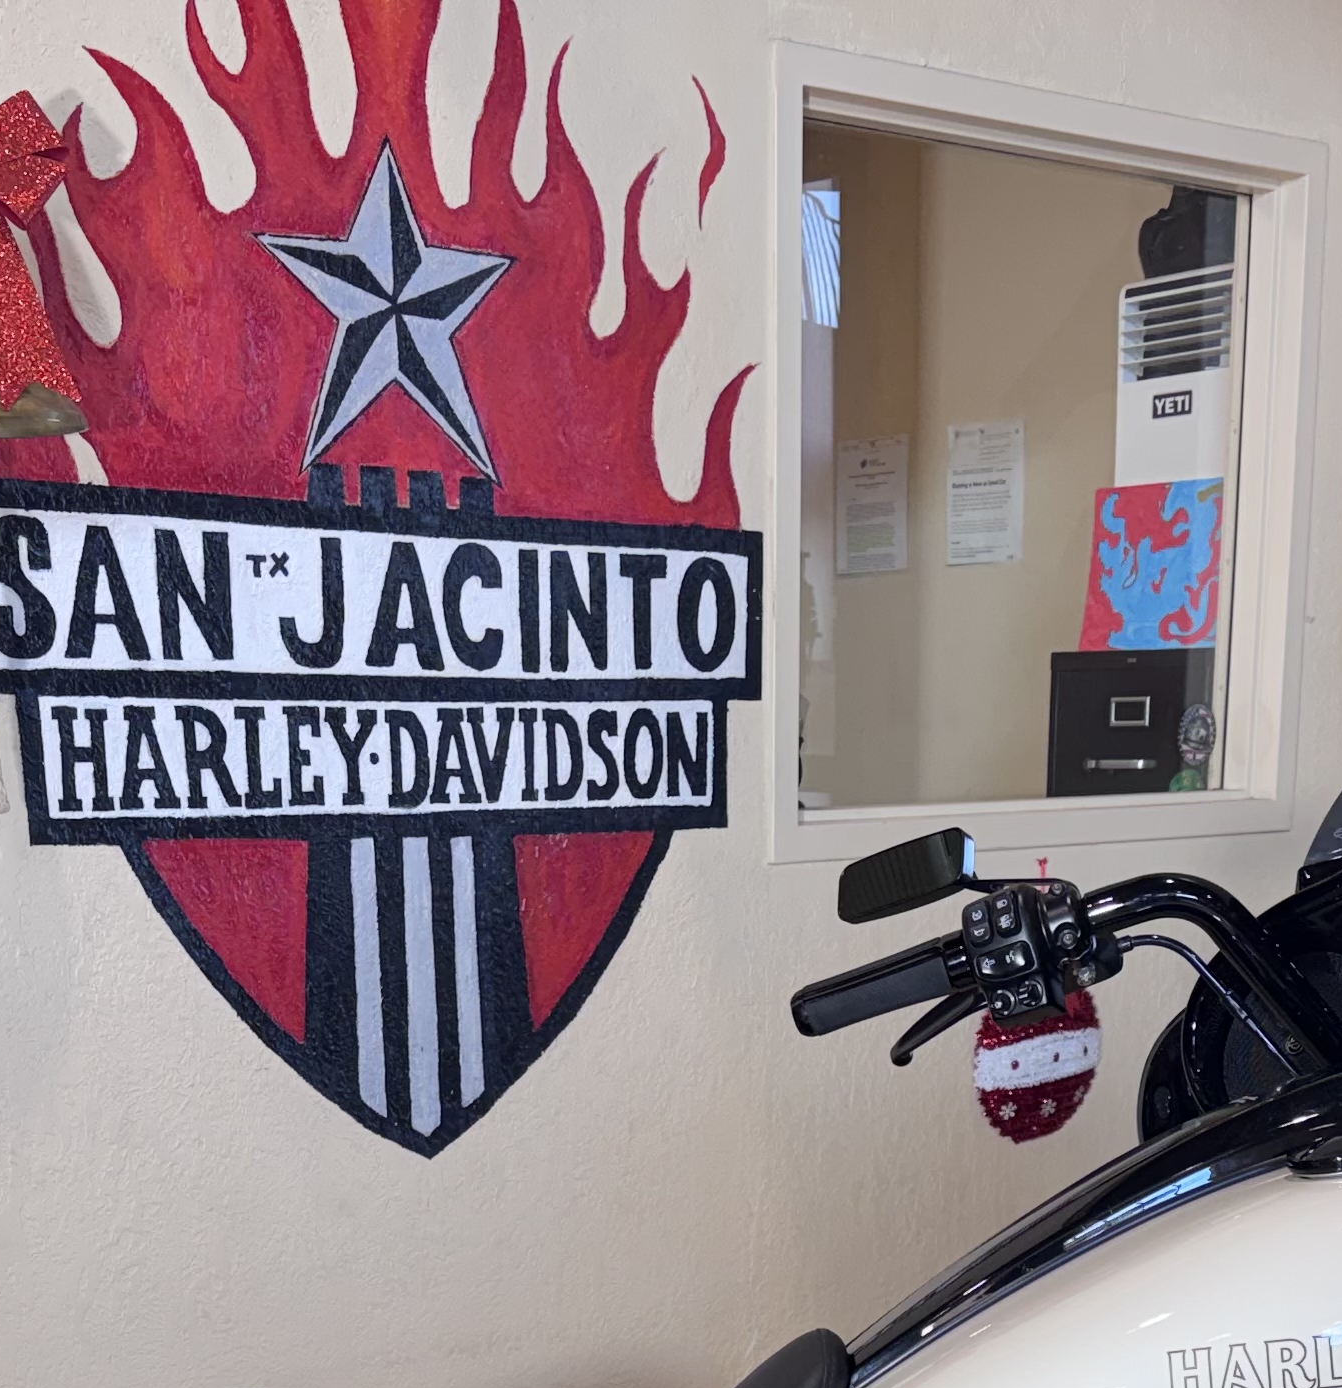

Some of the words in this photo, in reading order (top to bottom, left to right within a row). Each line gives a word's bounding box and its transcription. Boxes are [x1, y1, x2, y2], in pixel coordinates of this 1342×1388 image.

[1154, 394, 1190, 416] YETI
[246, 552, 289, 578] TX
[279, 537, 736, 673] JACINTO
